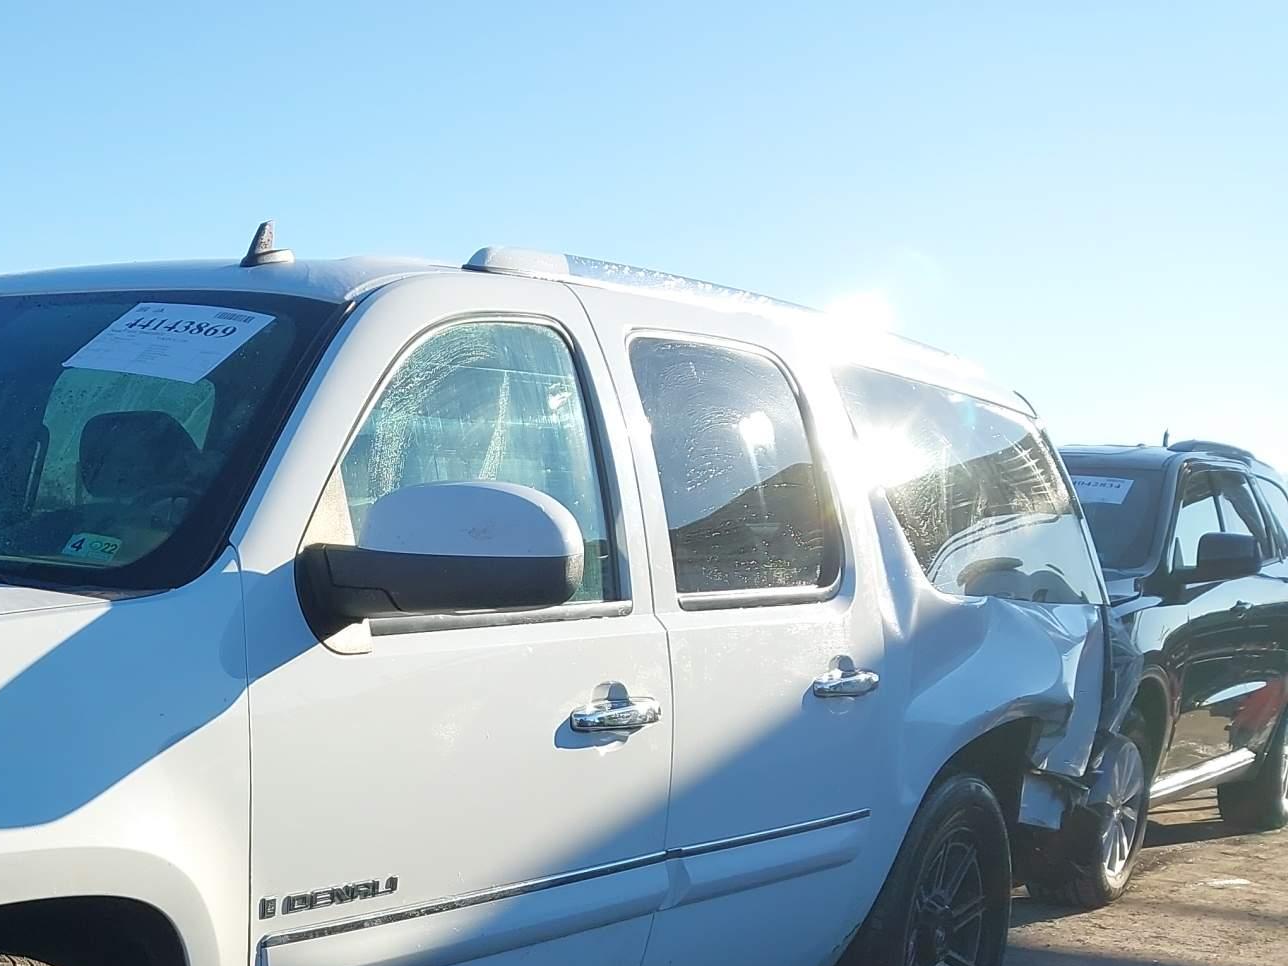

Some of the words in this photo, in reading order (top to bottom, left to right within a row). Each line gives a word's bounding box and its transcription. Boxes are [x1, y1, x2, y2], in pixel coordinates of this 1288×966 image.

[125, 317, 238, 338] 44143869
[70, 537, 86, 552] 4
[100, 542, 118, 555] 22
[281, 875, 399, 915] DENALI
